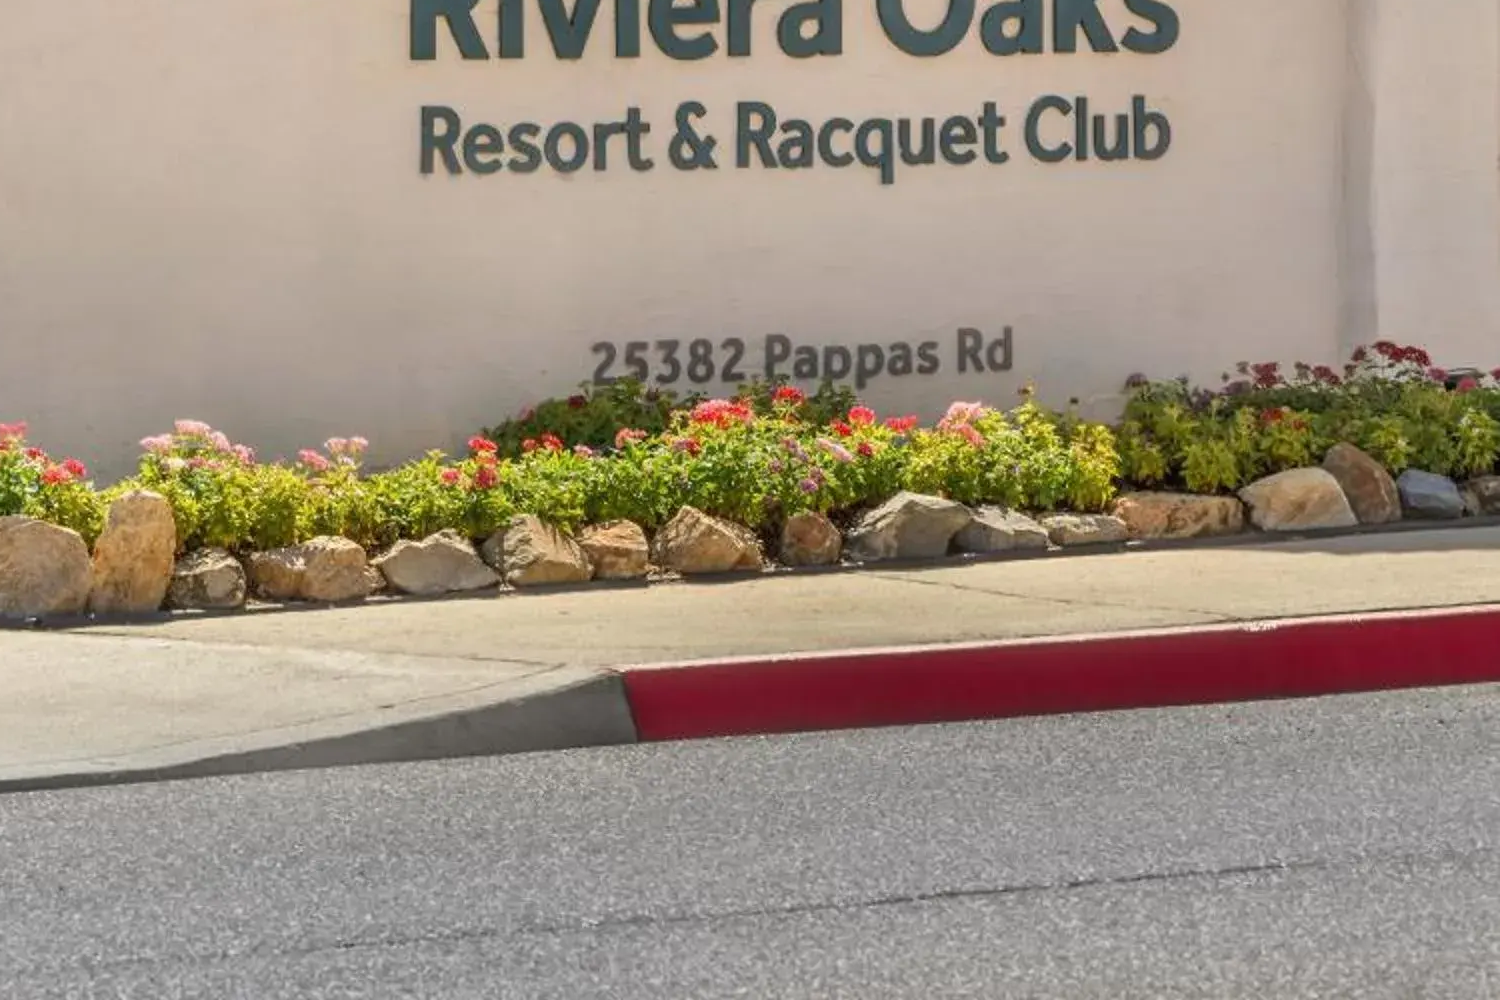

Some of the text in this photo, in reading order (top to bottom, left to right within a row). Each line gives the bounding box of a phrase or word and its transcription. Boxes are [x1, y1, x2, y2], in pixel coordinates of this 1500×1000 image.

[419, 94, 1172, 185] Resort & Racquet Club
[590, 325, 1014, 390] 25382 Pappas Rd
